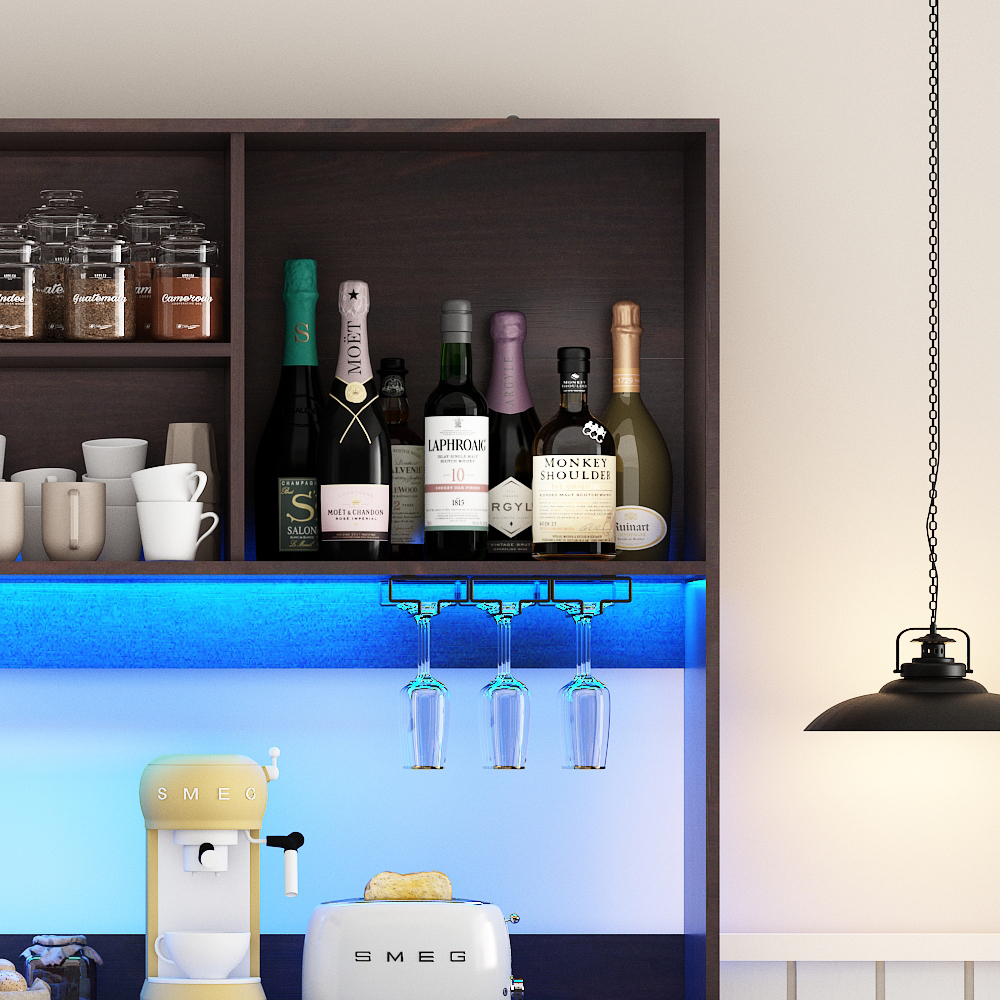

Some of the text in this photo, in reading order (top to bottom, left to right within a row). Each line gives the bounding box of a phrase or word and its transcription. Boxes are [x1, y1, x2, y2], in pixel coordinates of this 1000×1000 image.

[294, 322, 310, 343] S
[343, 320, 362, 375] MOËT
[503, 356, 514, 406] ARGYLE
[428, 438, 487, 452] LAPHROAIG
[544, 457, 608, 468] MONKEY
[451, 467, 466, 482] 10
[540, 470, 612, 481] SHOULDER
[393, 500, 401, 511] 2
[491, 502, 532, 512] RGYL
[287, 526, 317, 535] SALON
[157, 786, 257, 801] SMEG
[354, 950, 467, 963] SMEG
